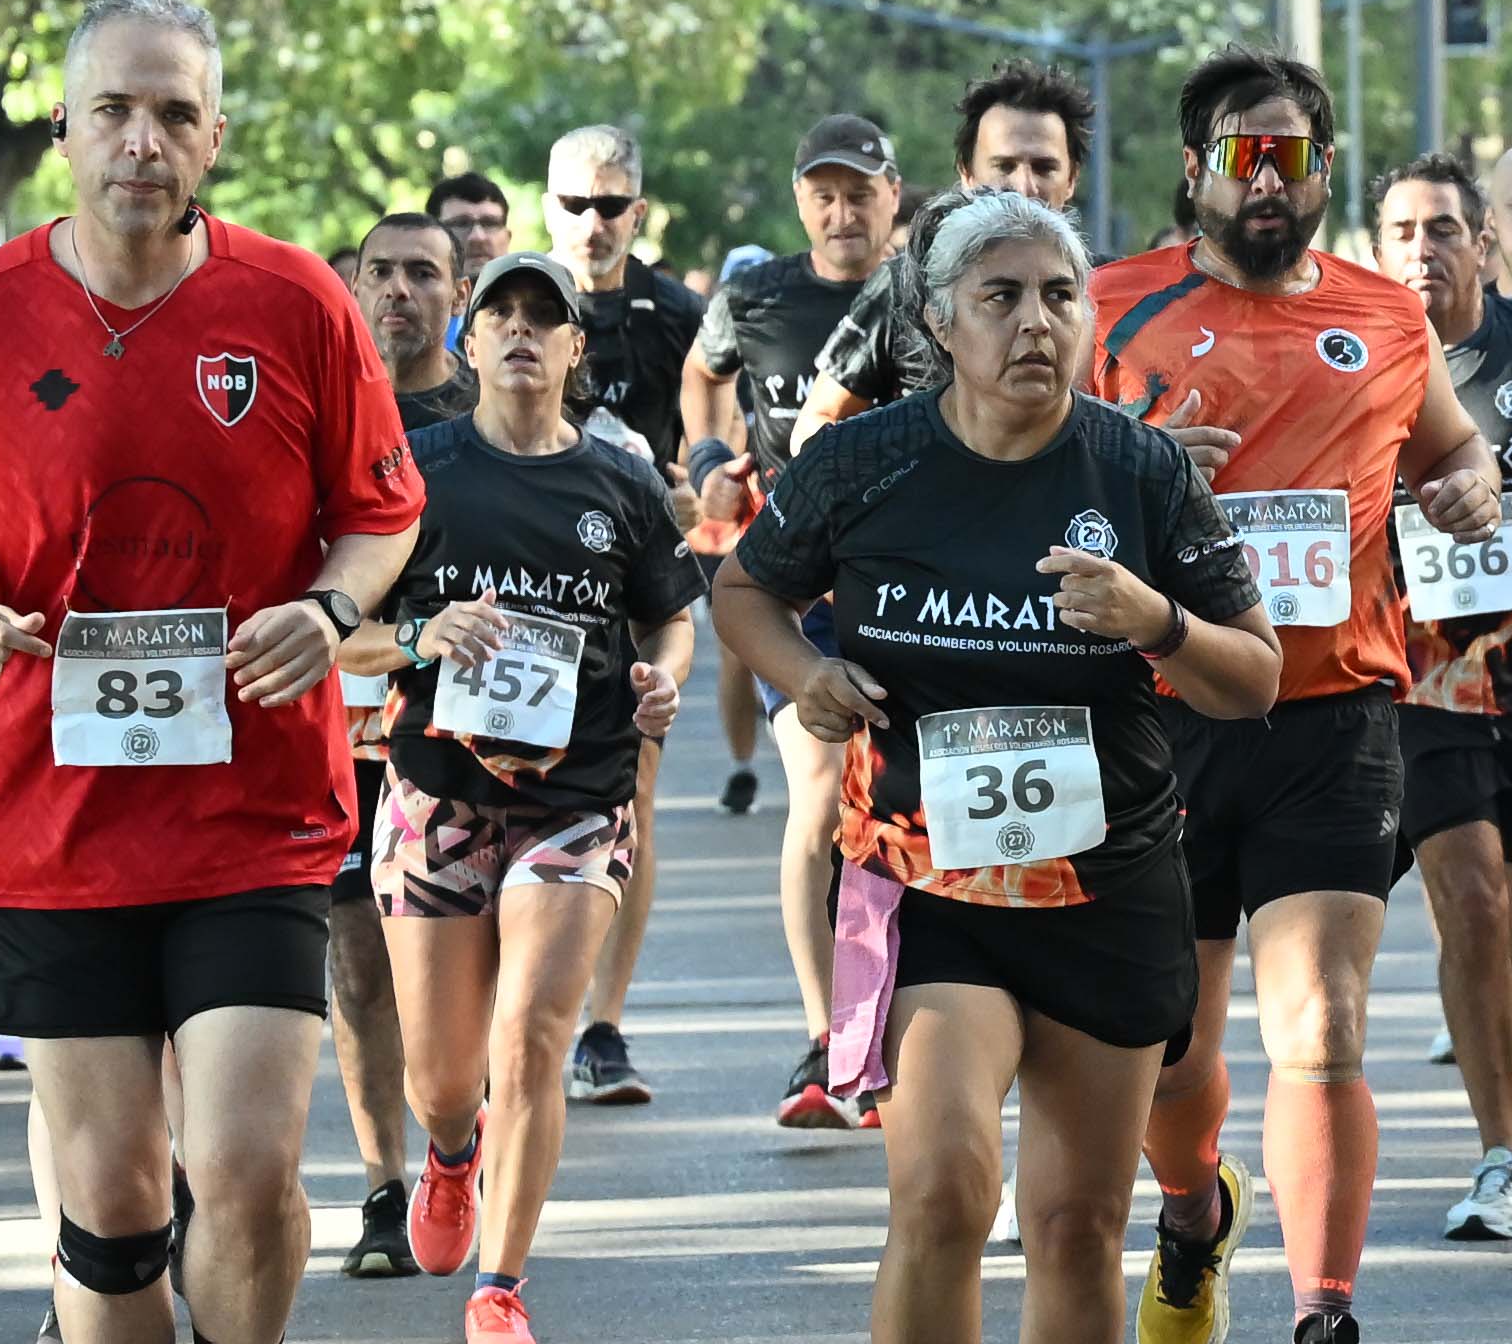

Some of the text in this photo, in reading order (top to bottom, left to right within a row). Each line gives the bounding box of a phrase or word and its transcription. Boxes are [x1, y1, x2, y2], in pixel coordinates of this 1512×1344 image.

[207, 374, 247, 391] NOB
[1248, 498, 1332, 523] MARATÓN
[1083, 525, 1102, 543] 27
[1415, 536, 1509, 584] 366
[471, 564, 610, 610] MARATÓN
[917, 587, 1060, 632] MARAT
[104, 618, 204, 646] MARATÓN
[857, 624, 1135, 656] ASOCIACIÓN BOMBEROS VOLUNTARIOS ROSARIO
[95, 669, 185, 719] 83
[452, 657, 560, 707] 457
[967, 712, 1068, 742] MARATÓN
[132, 736, 149, 750] 27
[965, 758, 1056, 821] 36
[1006, 834, 1024, 847] 27
